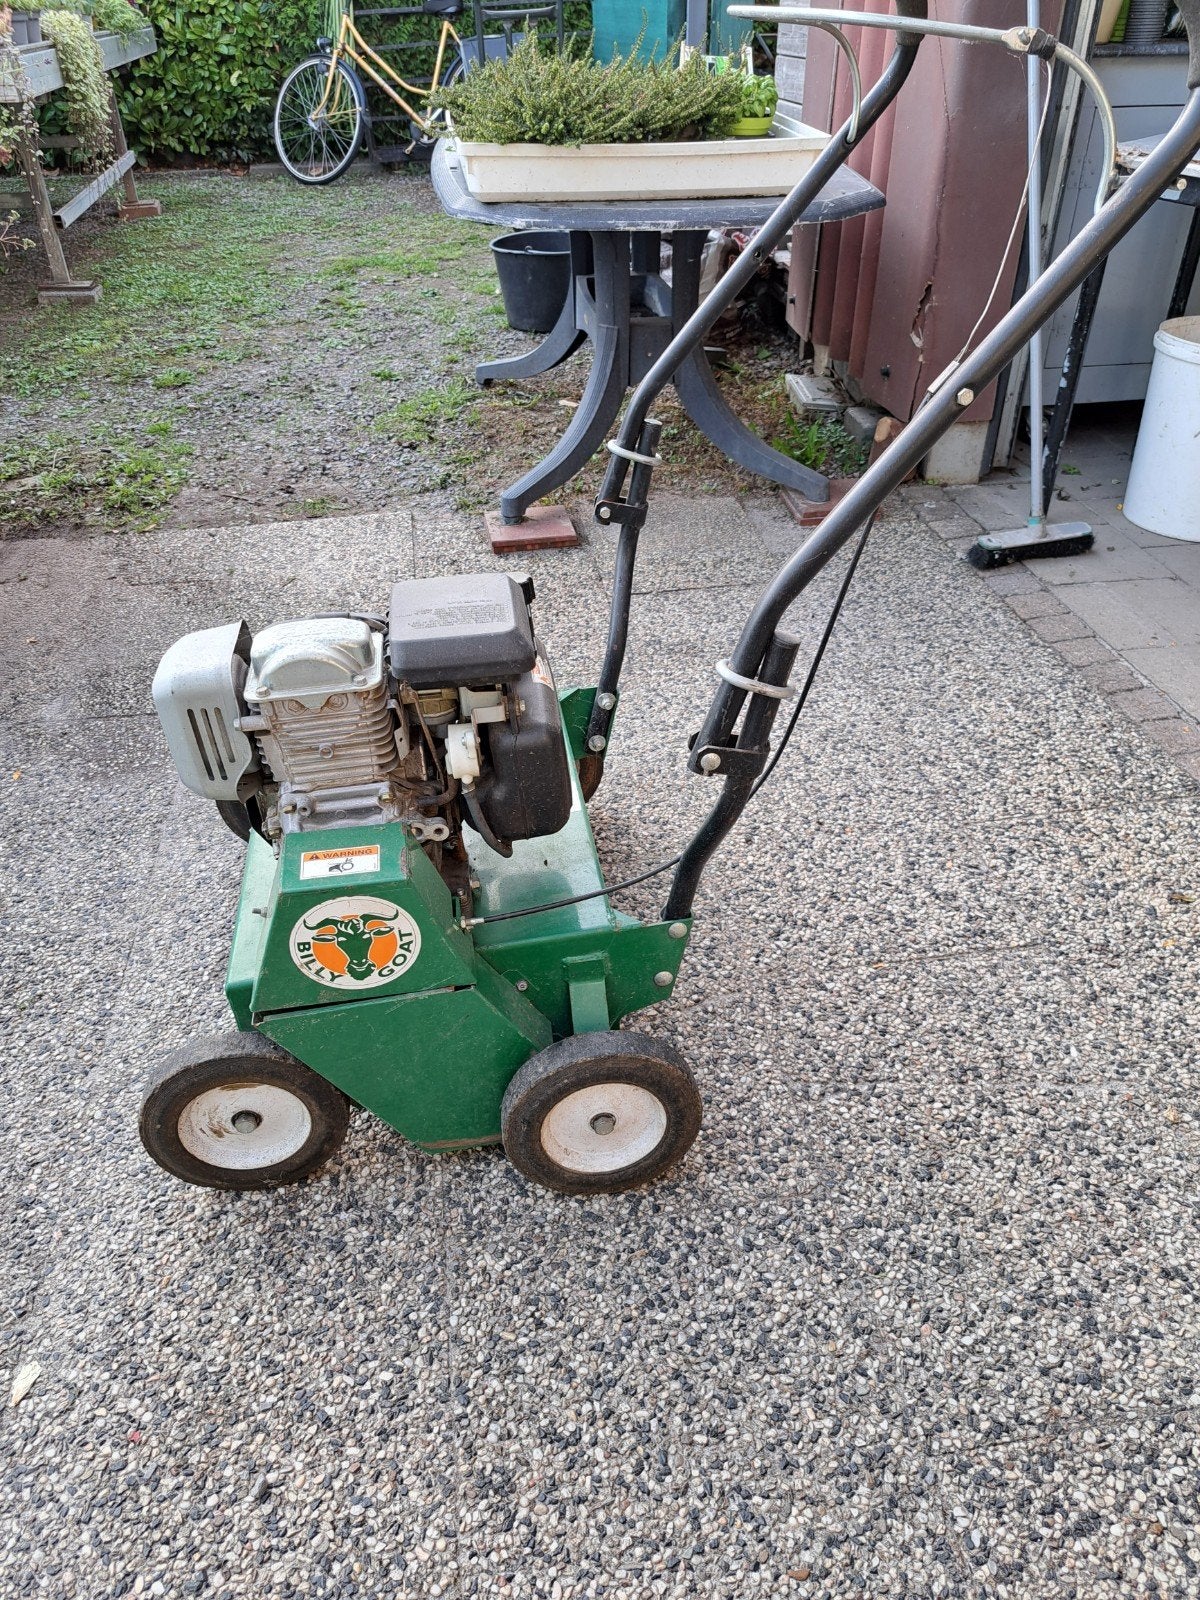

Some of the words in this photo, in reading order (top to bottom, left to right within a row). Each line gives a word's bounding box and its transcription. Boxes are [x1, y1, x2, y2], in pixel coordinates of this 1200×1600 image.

[322, 848, 373, 860] WARNING
[297, 941, 345, 982] BILLY
[378, 929, 413, 978] GOAT
